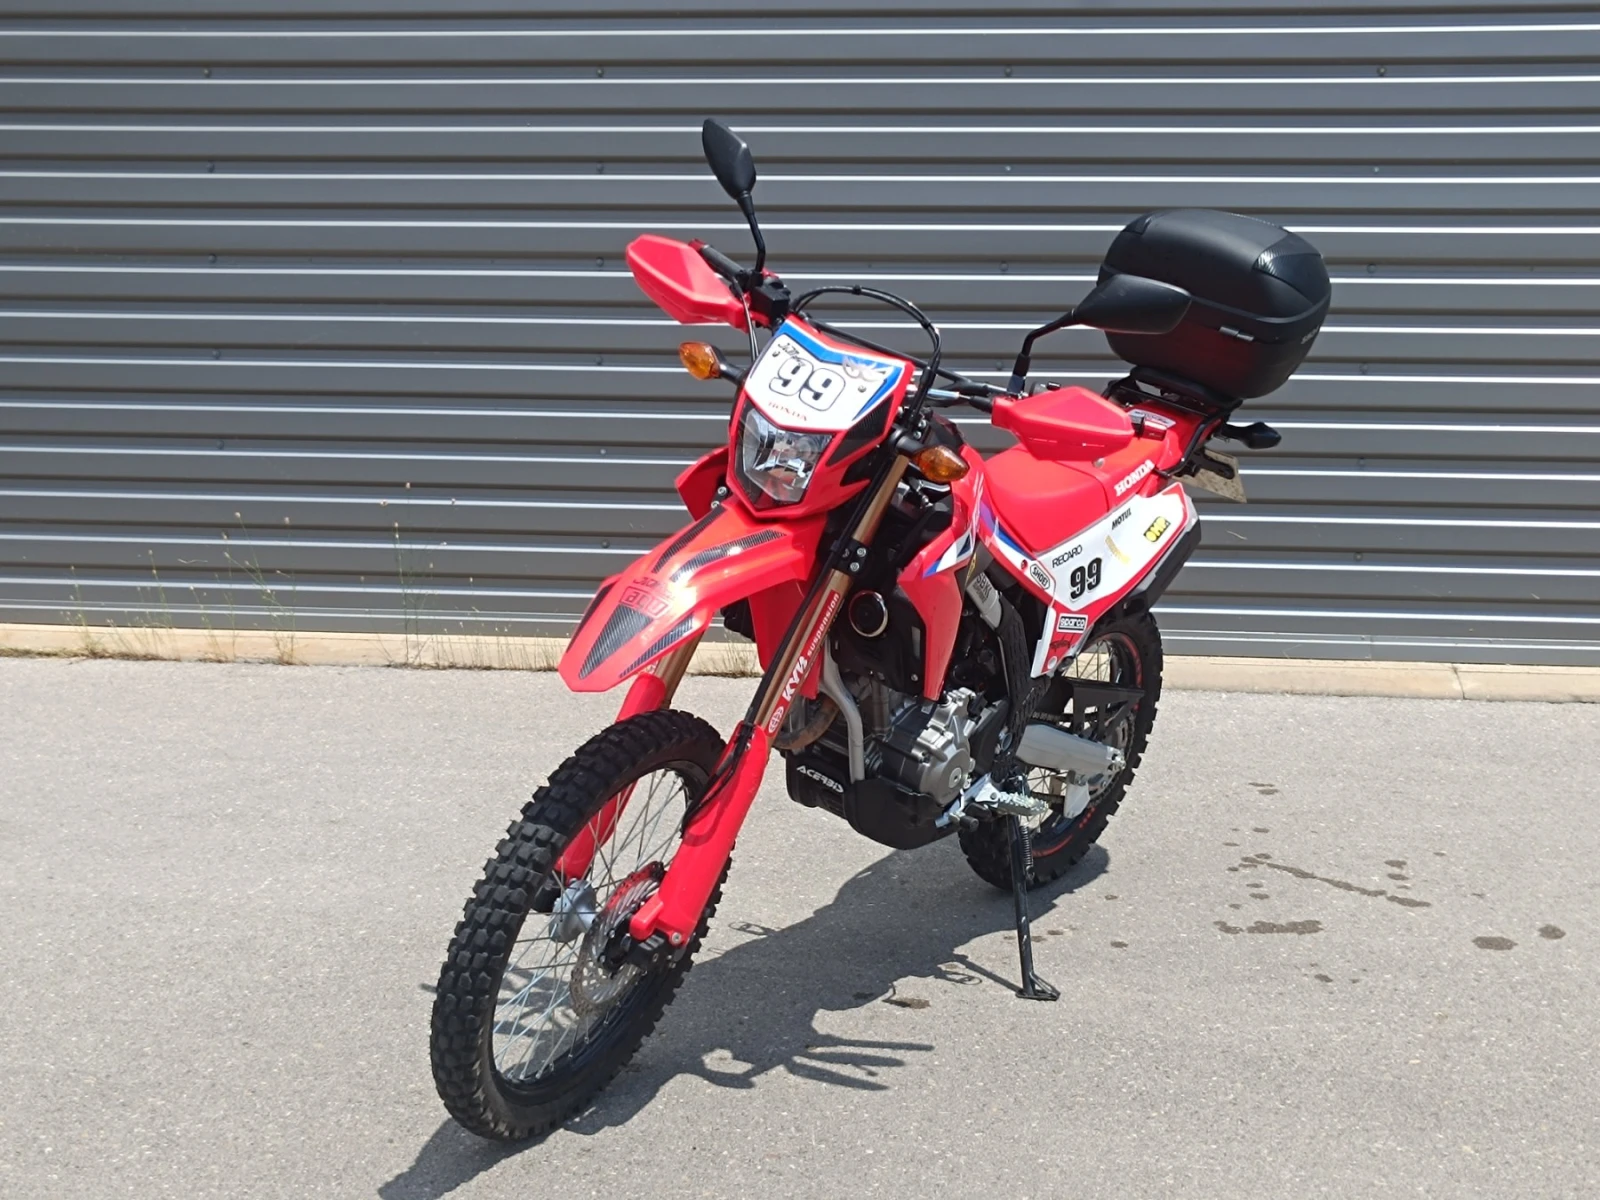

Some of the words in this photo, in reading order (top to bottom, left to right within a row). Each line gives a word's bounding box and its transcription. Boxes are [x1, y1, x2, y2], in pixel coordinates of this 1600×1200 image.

[768, 356, 846, 411] 99
[768, 401, 808, 422] HONDA
[1114, 459, 1155, 497] HONDA
[1111, 508, 1132, 530] MOTUL
[1144, 516, 1170, 542] OMP
[1052, 545, 1082, 568] RECARO
[1032, 567, 1049, 587] SHOEI
[1070, 557, 1102, 600] 99
[1059, 618, 1086, 628] sparco
[782, 656, 807, 702] KYB
[807, 593, 839, 656] suspension
[797, 765, 844, 793] ACERBIS
